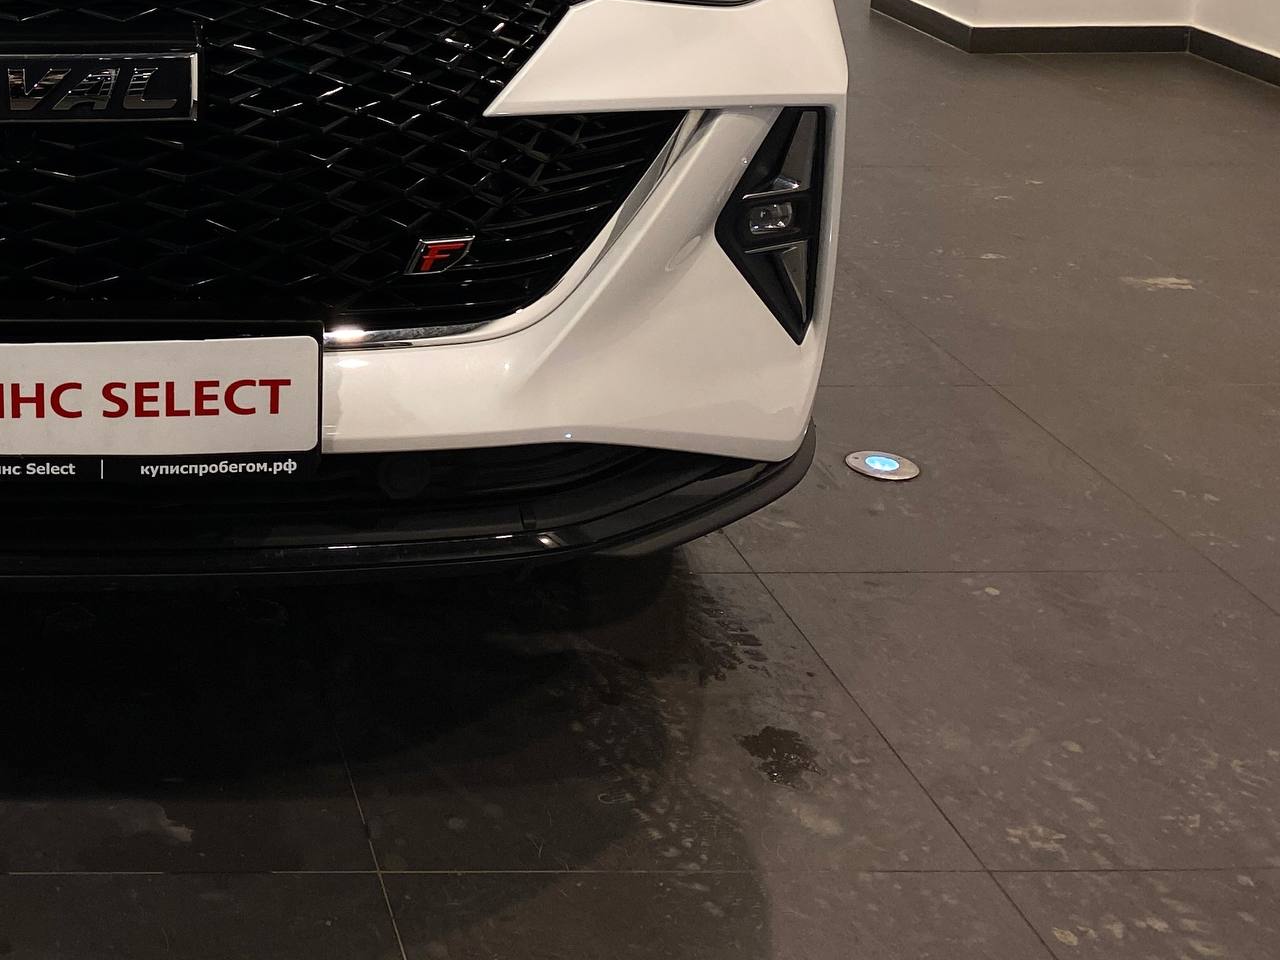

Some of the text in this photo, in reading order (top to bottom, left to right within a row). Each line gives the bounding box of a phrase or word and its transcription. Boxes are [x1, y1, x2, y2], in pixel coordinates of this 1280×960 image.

[419, 241, 467, 272] F
[101, 379, 292, 418] SELECT
[25, 462, 76, 475] Select
[140, 458, 297, 477] куписпробегом.рф
